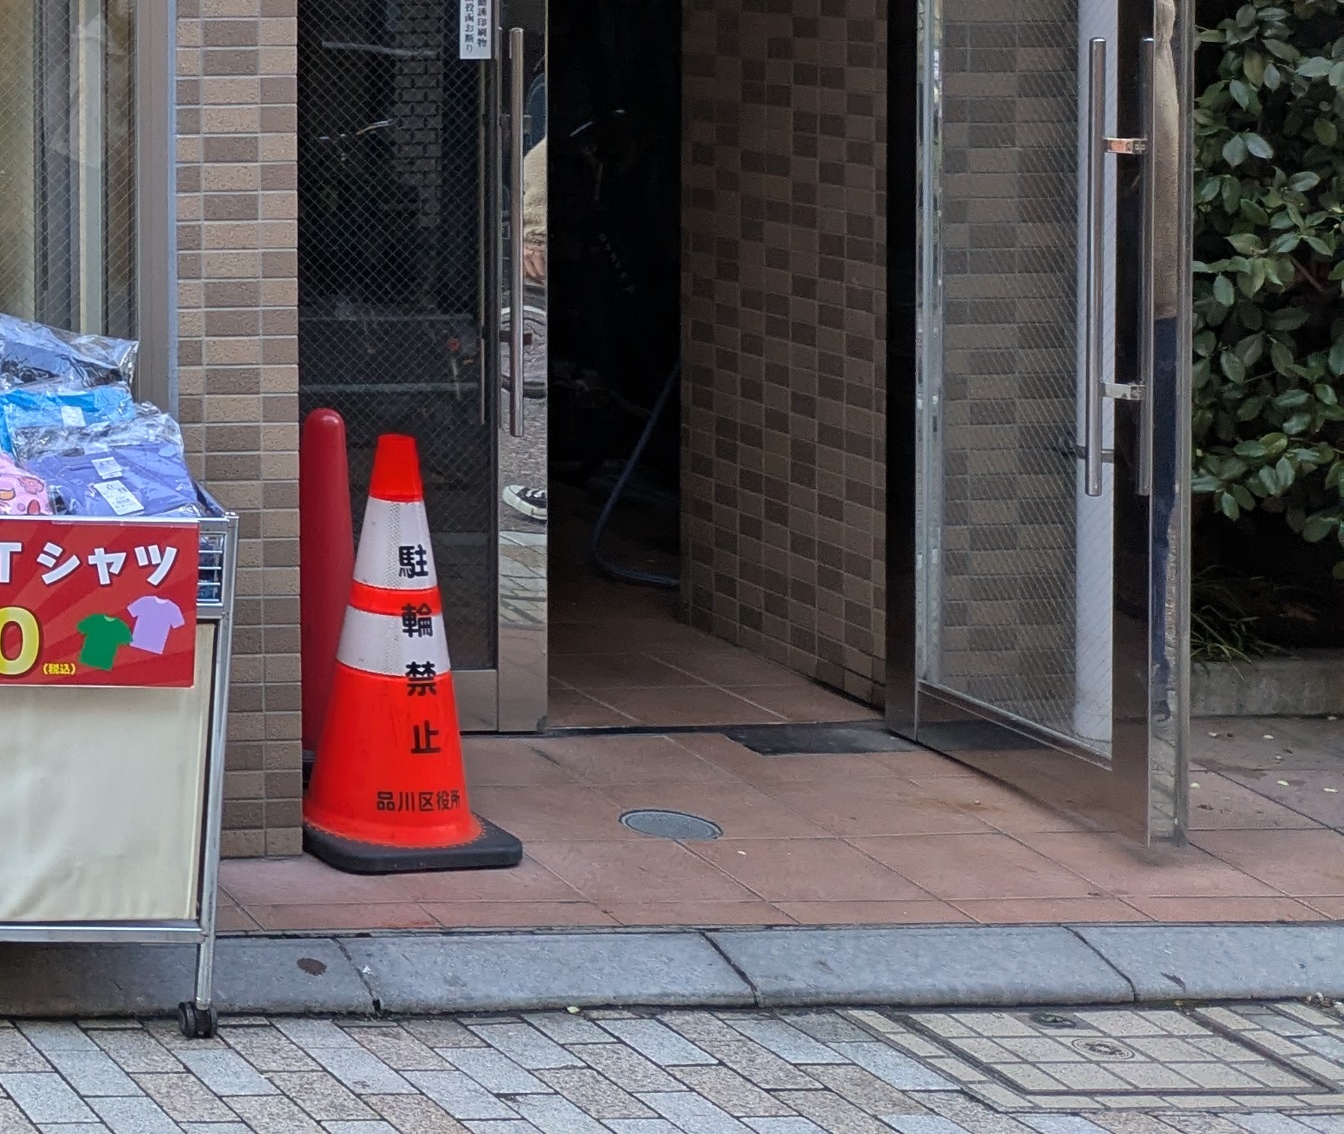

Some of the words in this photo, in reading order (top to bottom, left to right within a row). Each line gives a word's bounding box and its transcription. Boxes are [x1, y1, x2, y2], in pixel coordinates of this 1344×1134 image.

[398, 544, 441, 755] 駐輪禁止
[376, 788, 462, 814] 品川区役所
